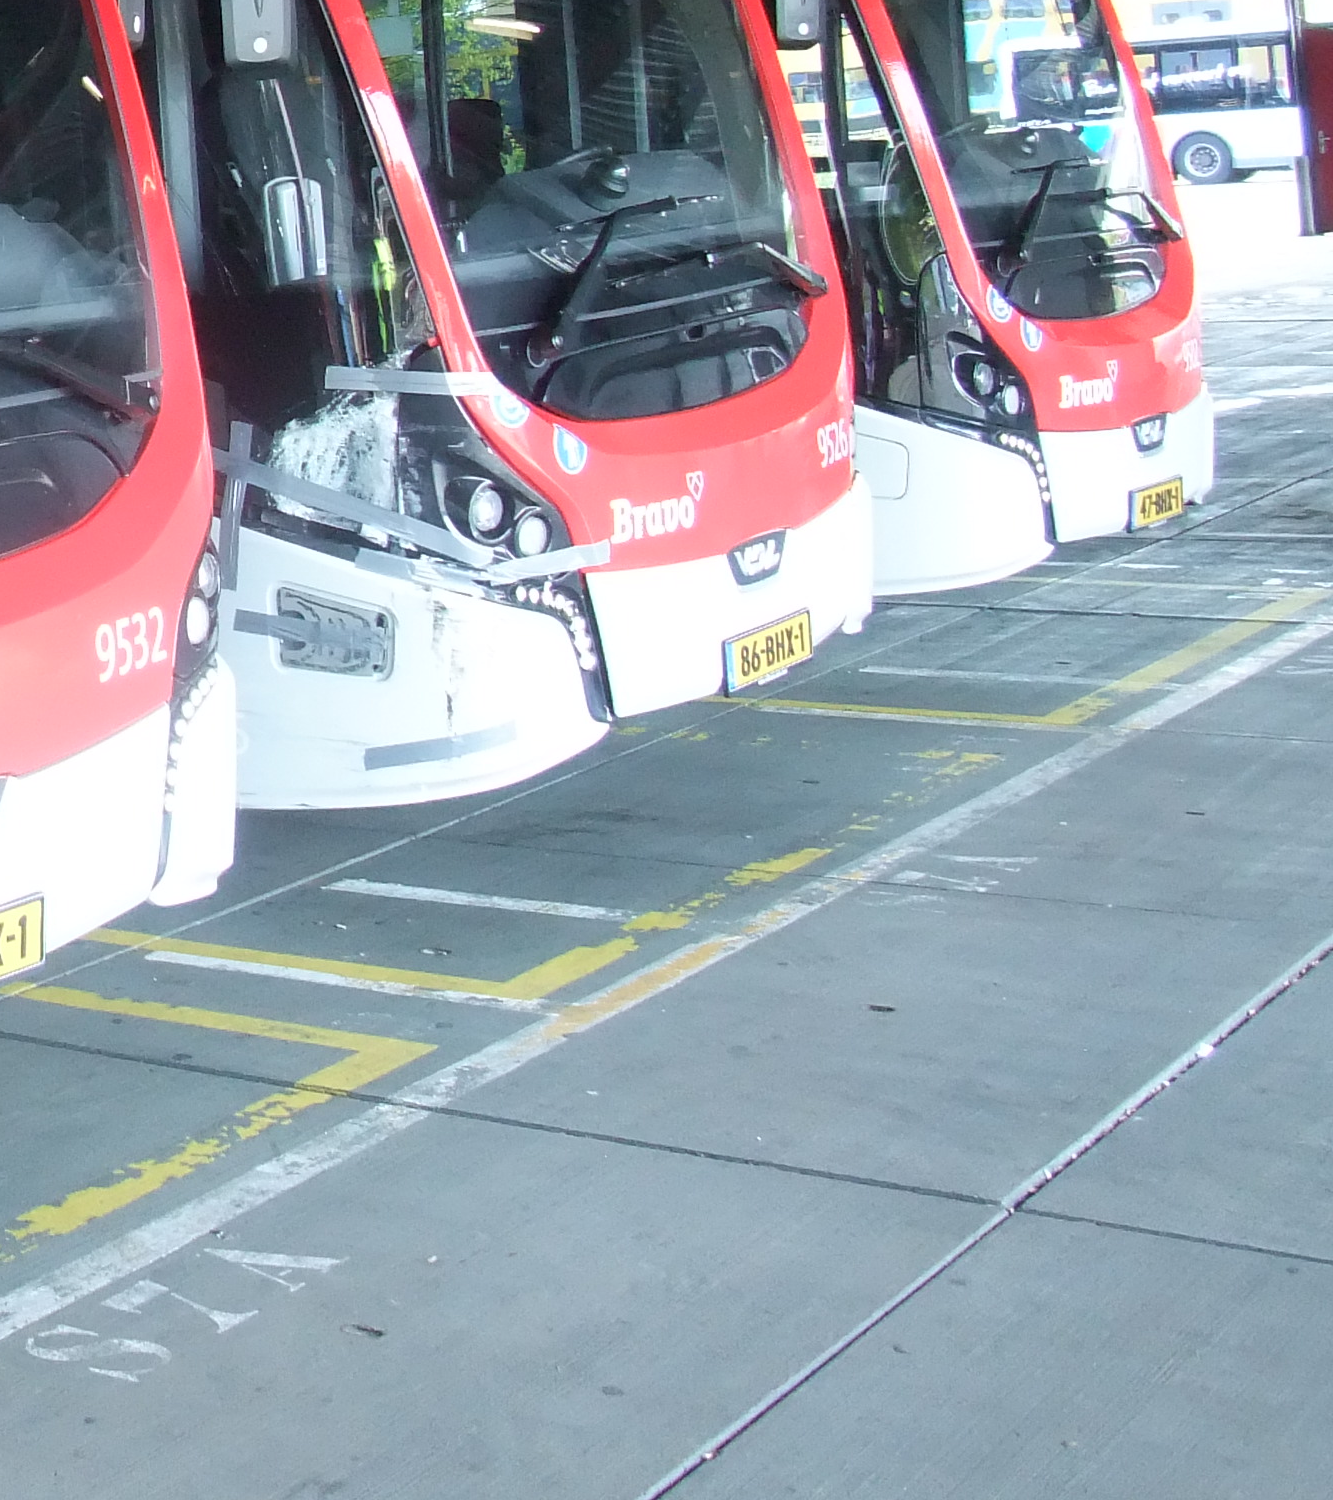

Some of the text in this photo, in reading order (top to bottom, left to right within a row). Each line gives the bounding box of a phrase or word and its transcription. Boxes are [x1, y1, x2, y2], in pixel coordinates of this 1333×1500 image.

[1058, 374, 1114, 409] Bravo
[816, 418, 849, 469] 9526
[609, 495, 695, 544] Bravo
[1139, 486, 1179, 520] 47-BHX-1
[733, 539, 781, 577] VDL
[95, 605, 168, 684] 9532
[740, 621, 806, 678] 86-BHX-1
